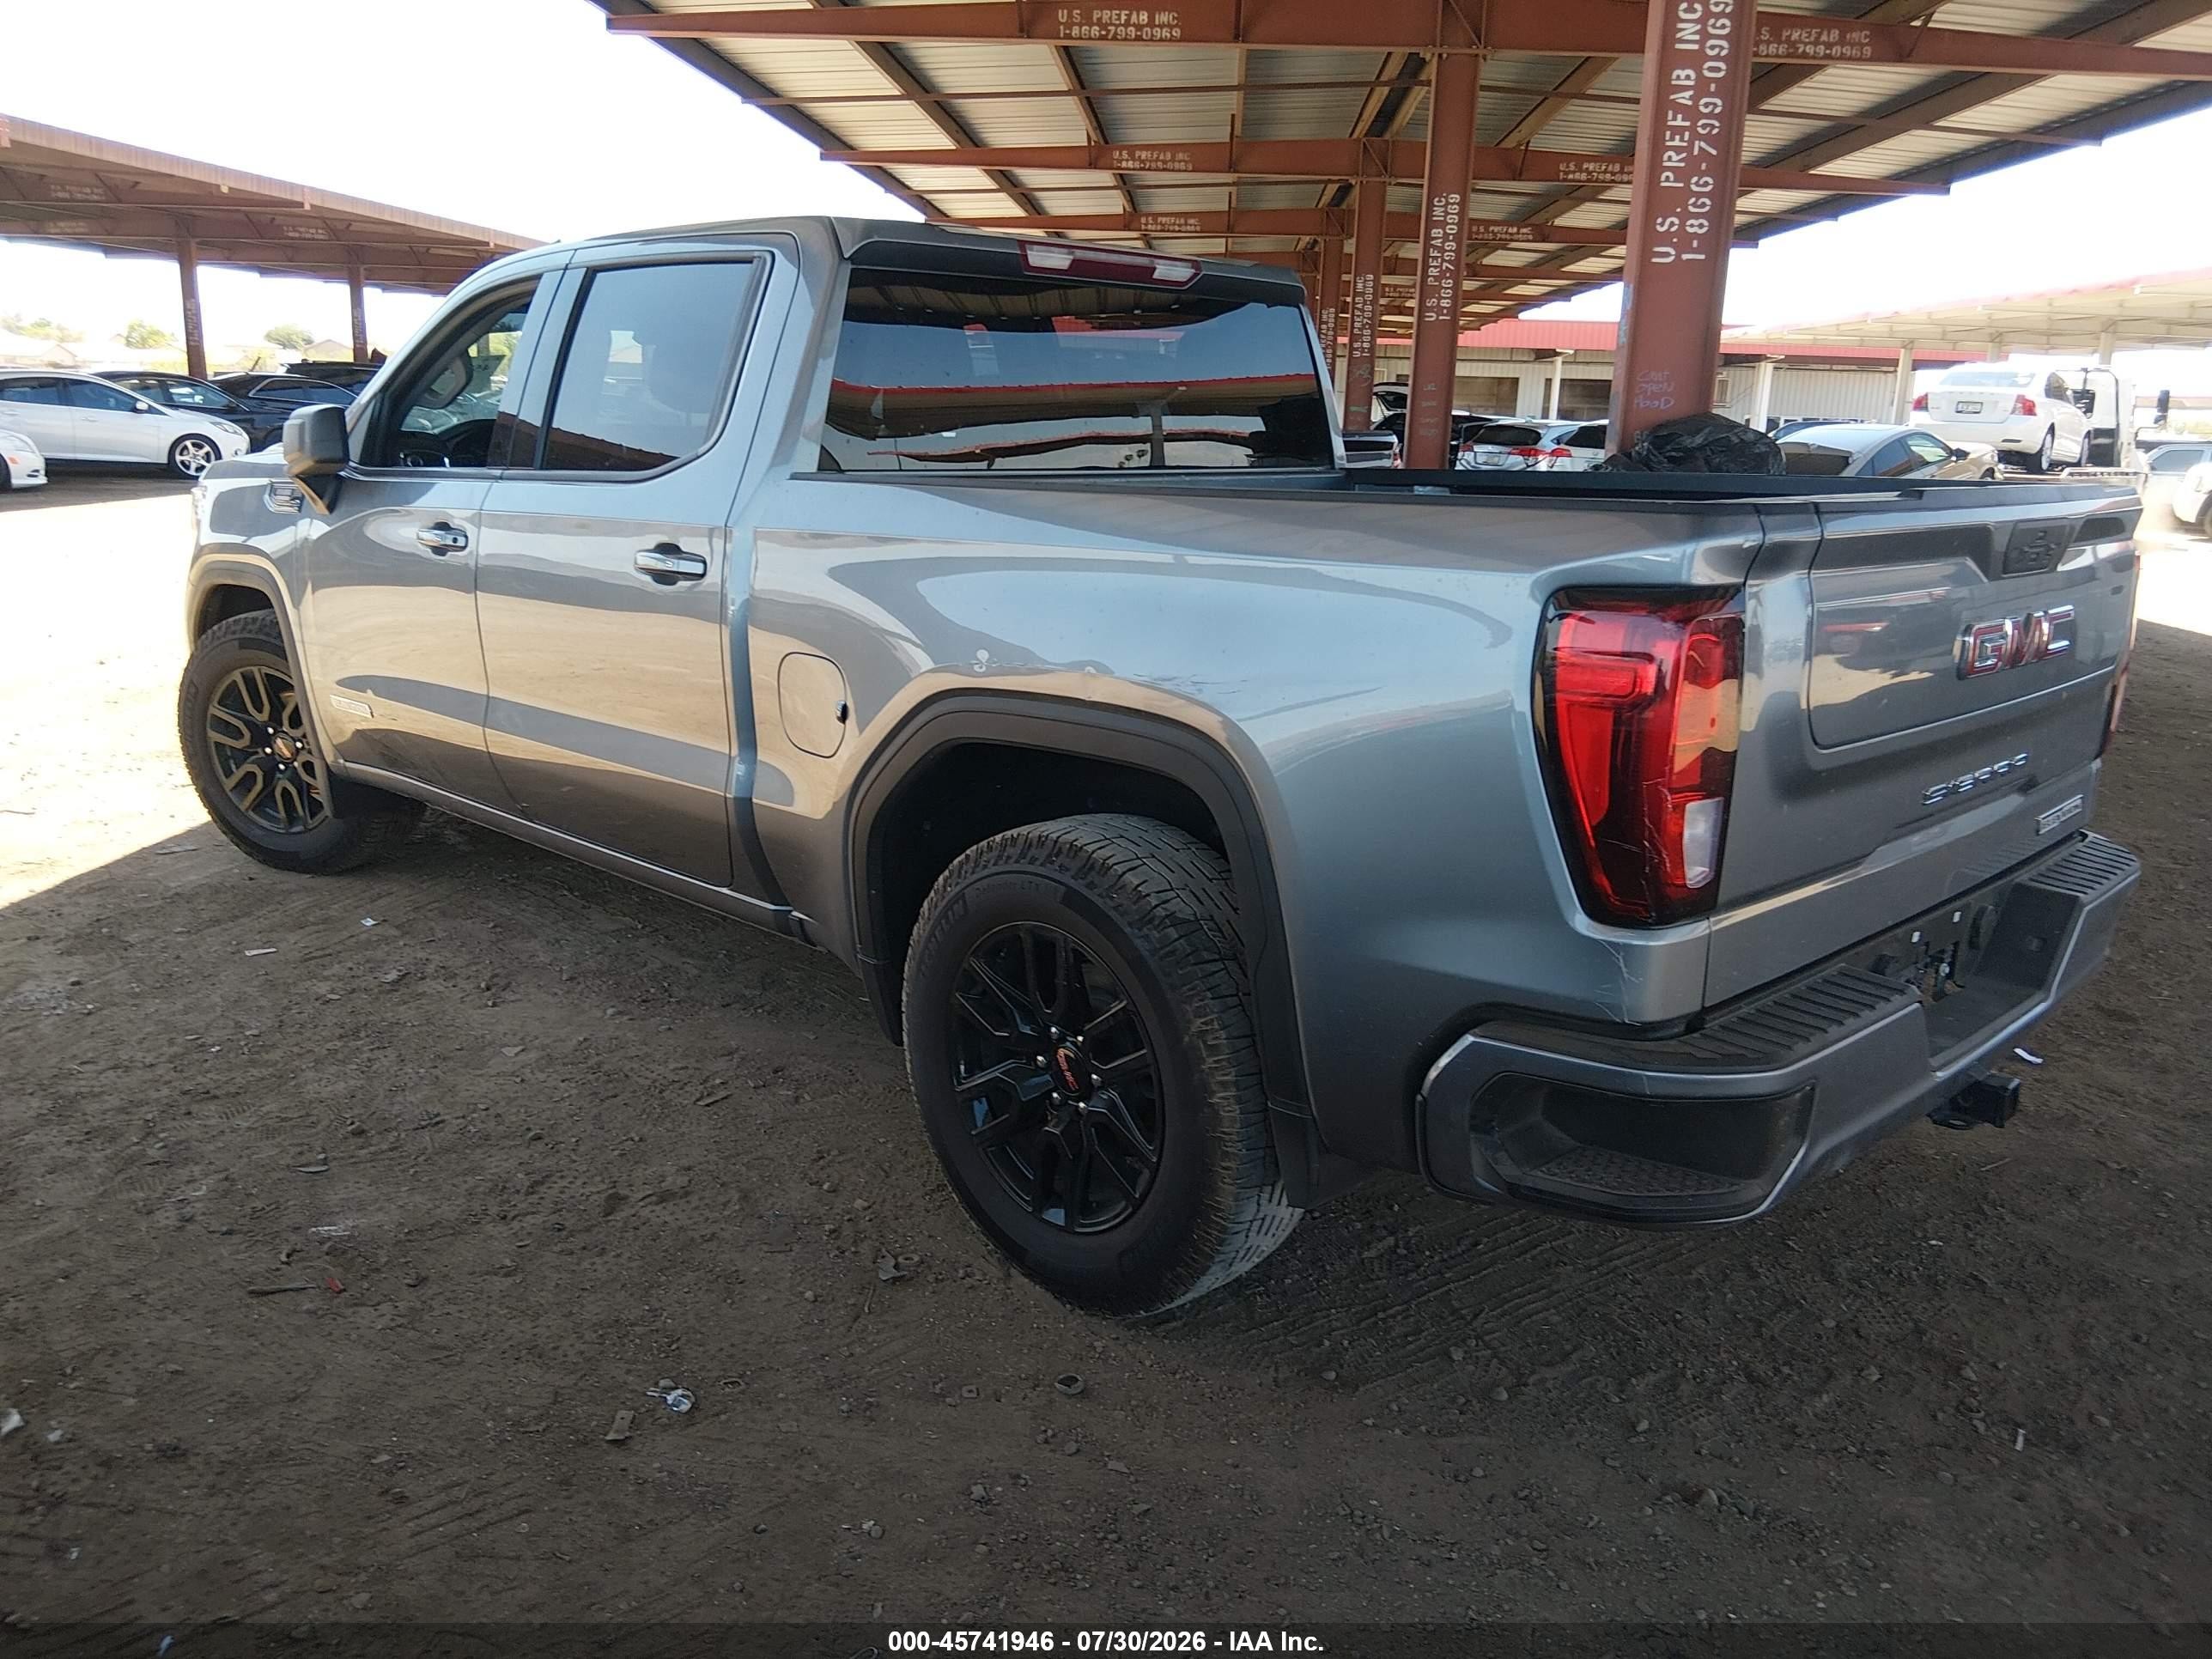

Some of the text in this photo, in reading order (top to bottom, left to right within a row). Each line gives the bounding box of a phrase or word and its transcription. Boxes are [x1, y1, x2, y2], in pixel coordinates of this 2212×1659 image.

[1058, 9, 1085, 23] U.S.
[1093, 9, 1148, 24] PREFAB
[1059, 26, 1182, 40] 1-866-799-0969
[1782, 27, 1839, 42] PREFAB
[1753, 43, 1872, 58] -866-799-0969
[1660, 69, 1697, 187] PREFAB
[1681, 0, 1734, 260] 1-866-799-0969
[1583, 162, 1620, 172] PREFAB
[1424, 192, 1446, 321] U.S. PREFAB INC.
[1438, 193, 1461, 320] 1-866-799-0969
[1650, 207, 1681, 264] U.S.
[1955, 605, 2075, 679] GMC
